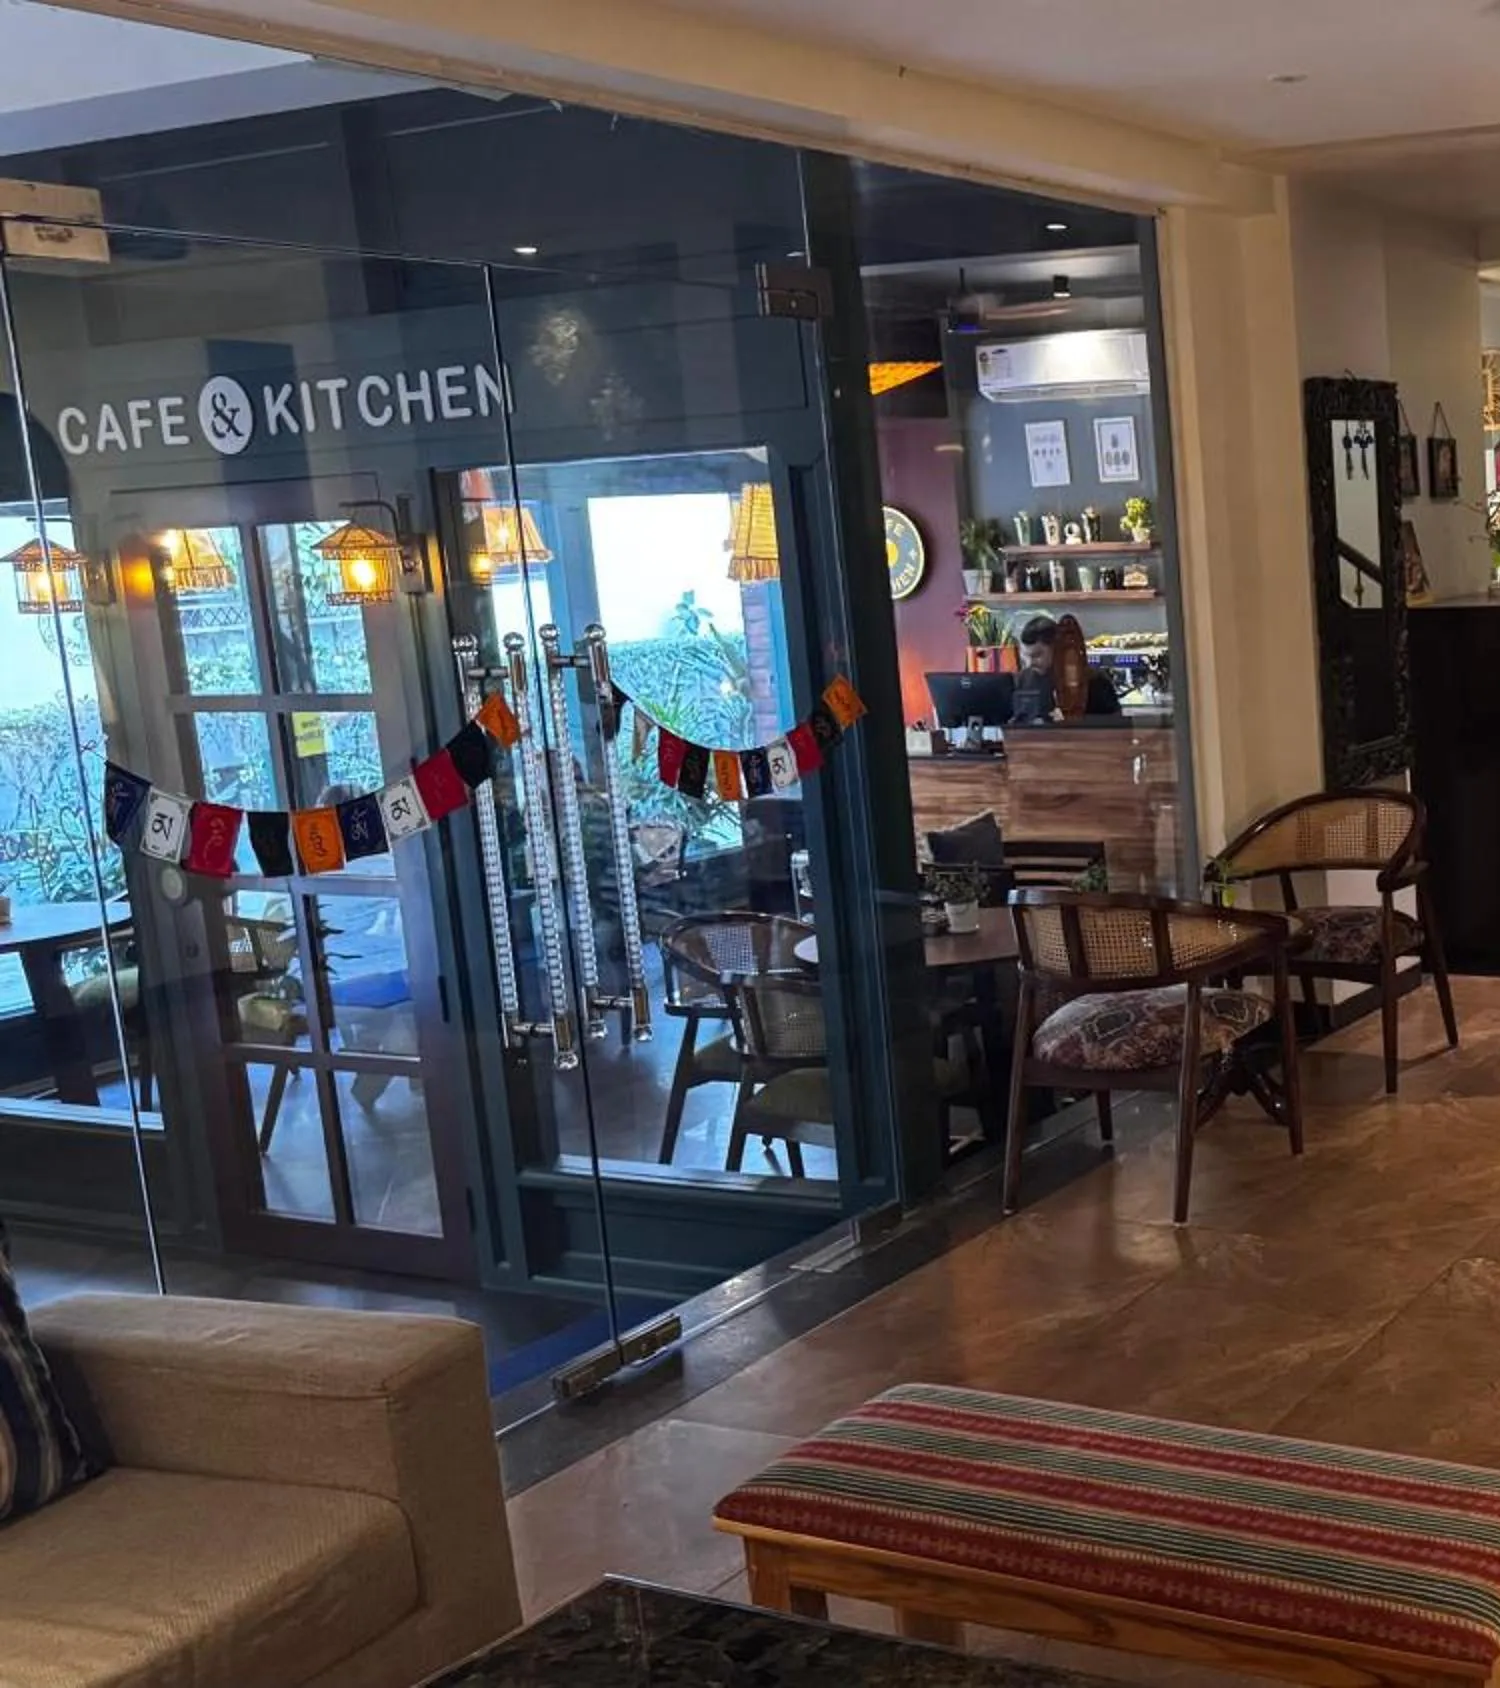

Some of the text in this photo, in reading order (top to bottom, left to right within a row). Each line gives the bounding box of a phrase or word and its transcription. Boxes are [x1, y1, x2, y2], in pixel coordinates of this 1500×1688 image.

[58, 363, 514, 455] CAFE & KITCHEN
